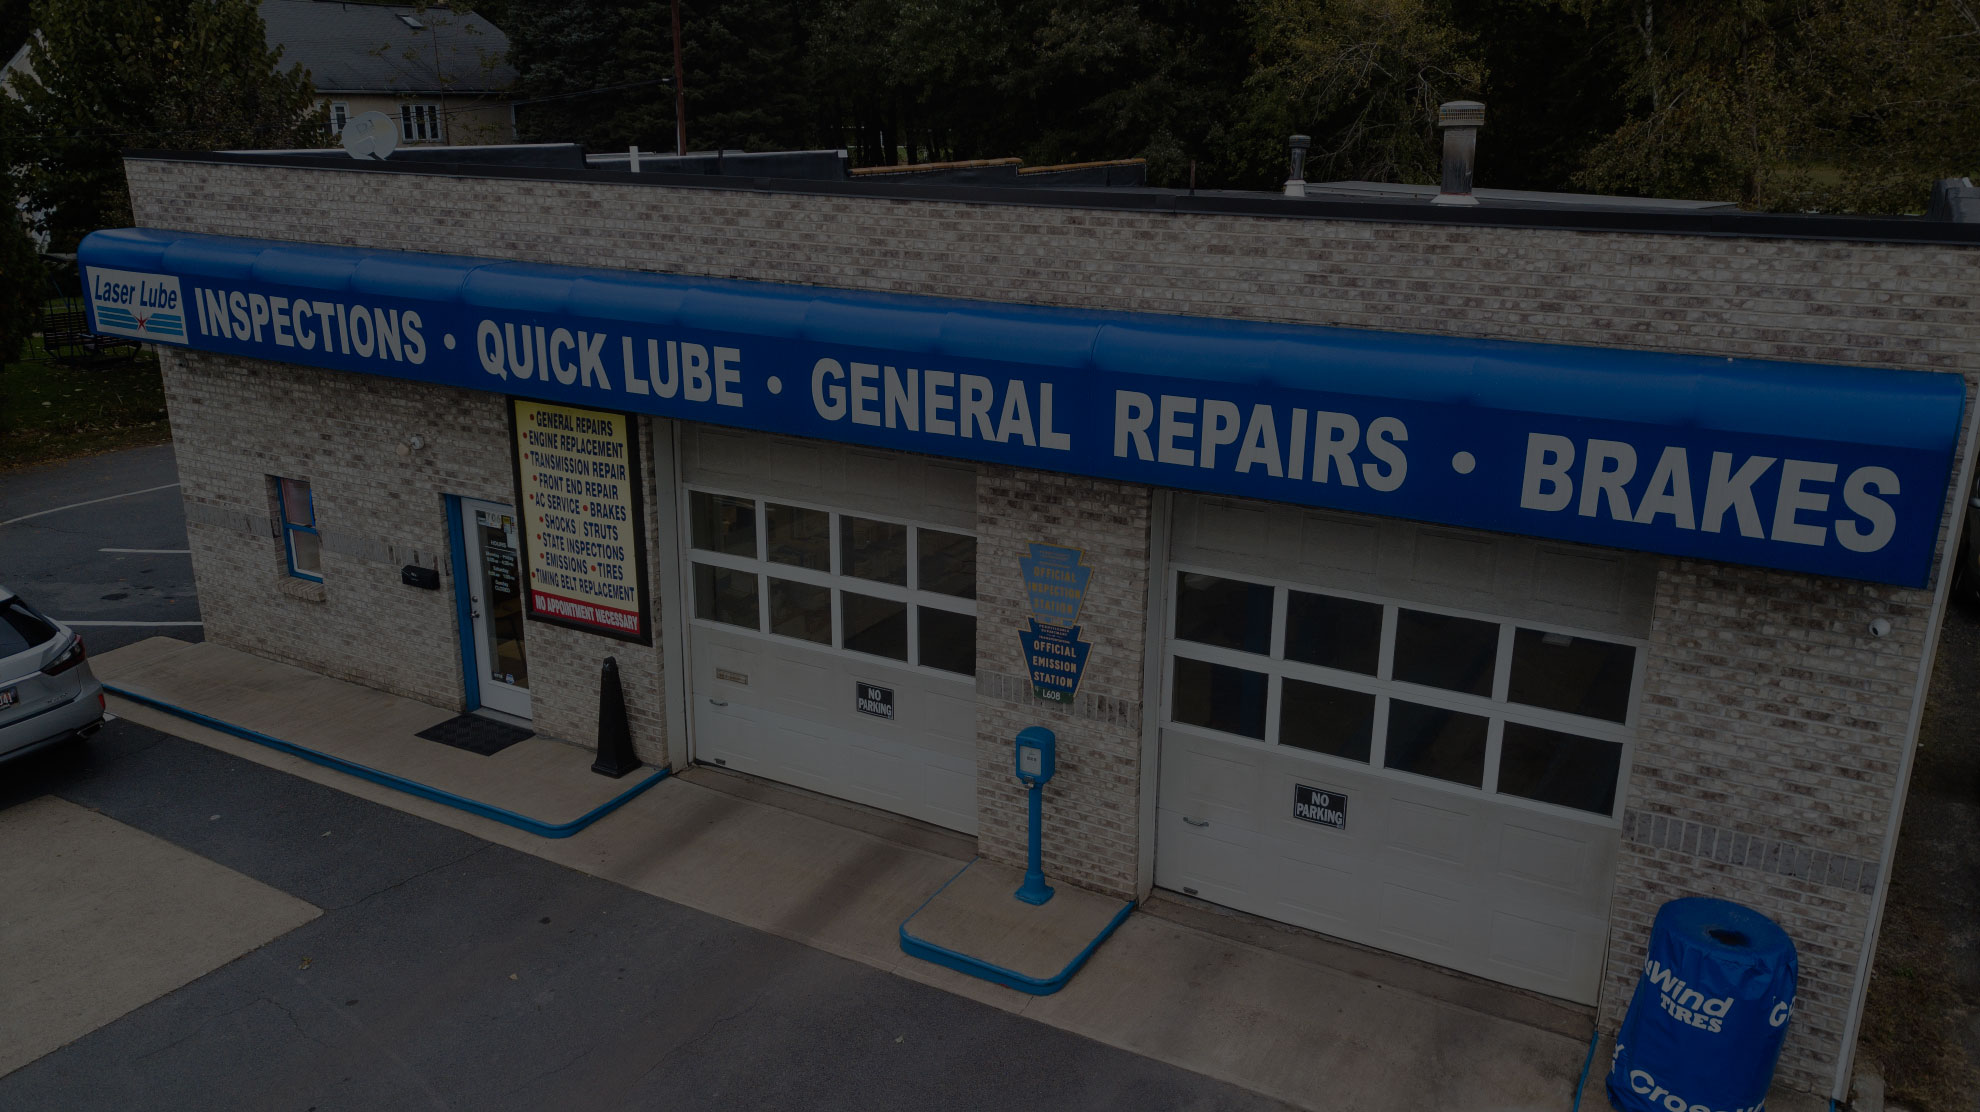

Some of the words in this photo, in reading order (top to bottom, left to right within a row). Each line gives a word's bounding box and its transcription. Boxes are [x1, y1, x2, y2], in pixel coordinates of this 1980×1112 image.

[95, 275, 135, 304] Laser
[140, 281, 177, 309] Lube
[194, 287, 427, 364] INSPECTIONS
[476, 319, 611, 391] QUICK
[621, 336, 744, 408] LUBE
[812, 358, 1071, 451] GENERAL
[1114, 389, 1409, 492] REPAIRS
[1520, 432, 1901, 553] BRAKES
[537, 411, 574, 433] GENERAL
[576, 416, 613, 437] REPAIRS
[529, 430, 558, 450] ENGINE
[560, 434, 623, 459] REPLACEMENT
[530, 451, 590, 476] TRANSMISSION
[593, 460, 626, 481] REPAIR
[539, 473, 563, 493] FRONT
[566, 478, 583, 495] END
[585, 481, 618, 500] REPAIR
[535, 492, 546, 507] AC
[547, 494, 580, 515] SERVICE
[590, 501, 627, 522] BRAKES
[545, 514, 576, 535] SHOCKS
[584, 521, 618, 541] STRUTS
[542, 532, 565, 551] STATE
[567, 537, 625, 561] INSPECTIONS
[546, 552, 588, 575] EMISSIONS
[597, 562, 623, 580] TIRES
[1034, 566, 1076, 583] OFFICIAL
[536, 568, 560, 588] TIMING
[560, 573, 578, 591] BELT
[579, 577, 635, 602] REPLACEMENT
[1028, 581, 1080, 600] INSPECTION
[535, 594, 545, 610] NO
[546, 597, 594, 622] APPOINTMENT
[596, 605, 638, 631] NECESSARY
[1034, 597, 1073, 615] STATION
[1033, 640, 1076, 658] OFFICIAL
[1033, 655, 1077, 673] EMISSION
[1034, 671, 1073, 688] STATION
[858, 698, 892, 716] PARKING
[868, 687, 882, 701] NO
[1042, 689, 1061, 700] L608
[1311, 791, 1330, 807] NO
[1296, 803, 1343, 825] PARKING
[1660, 993, 1723, 1033] TIRES
